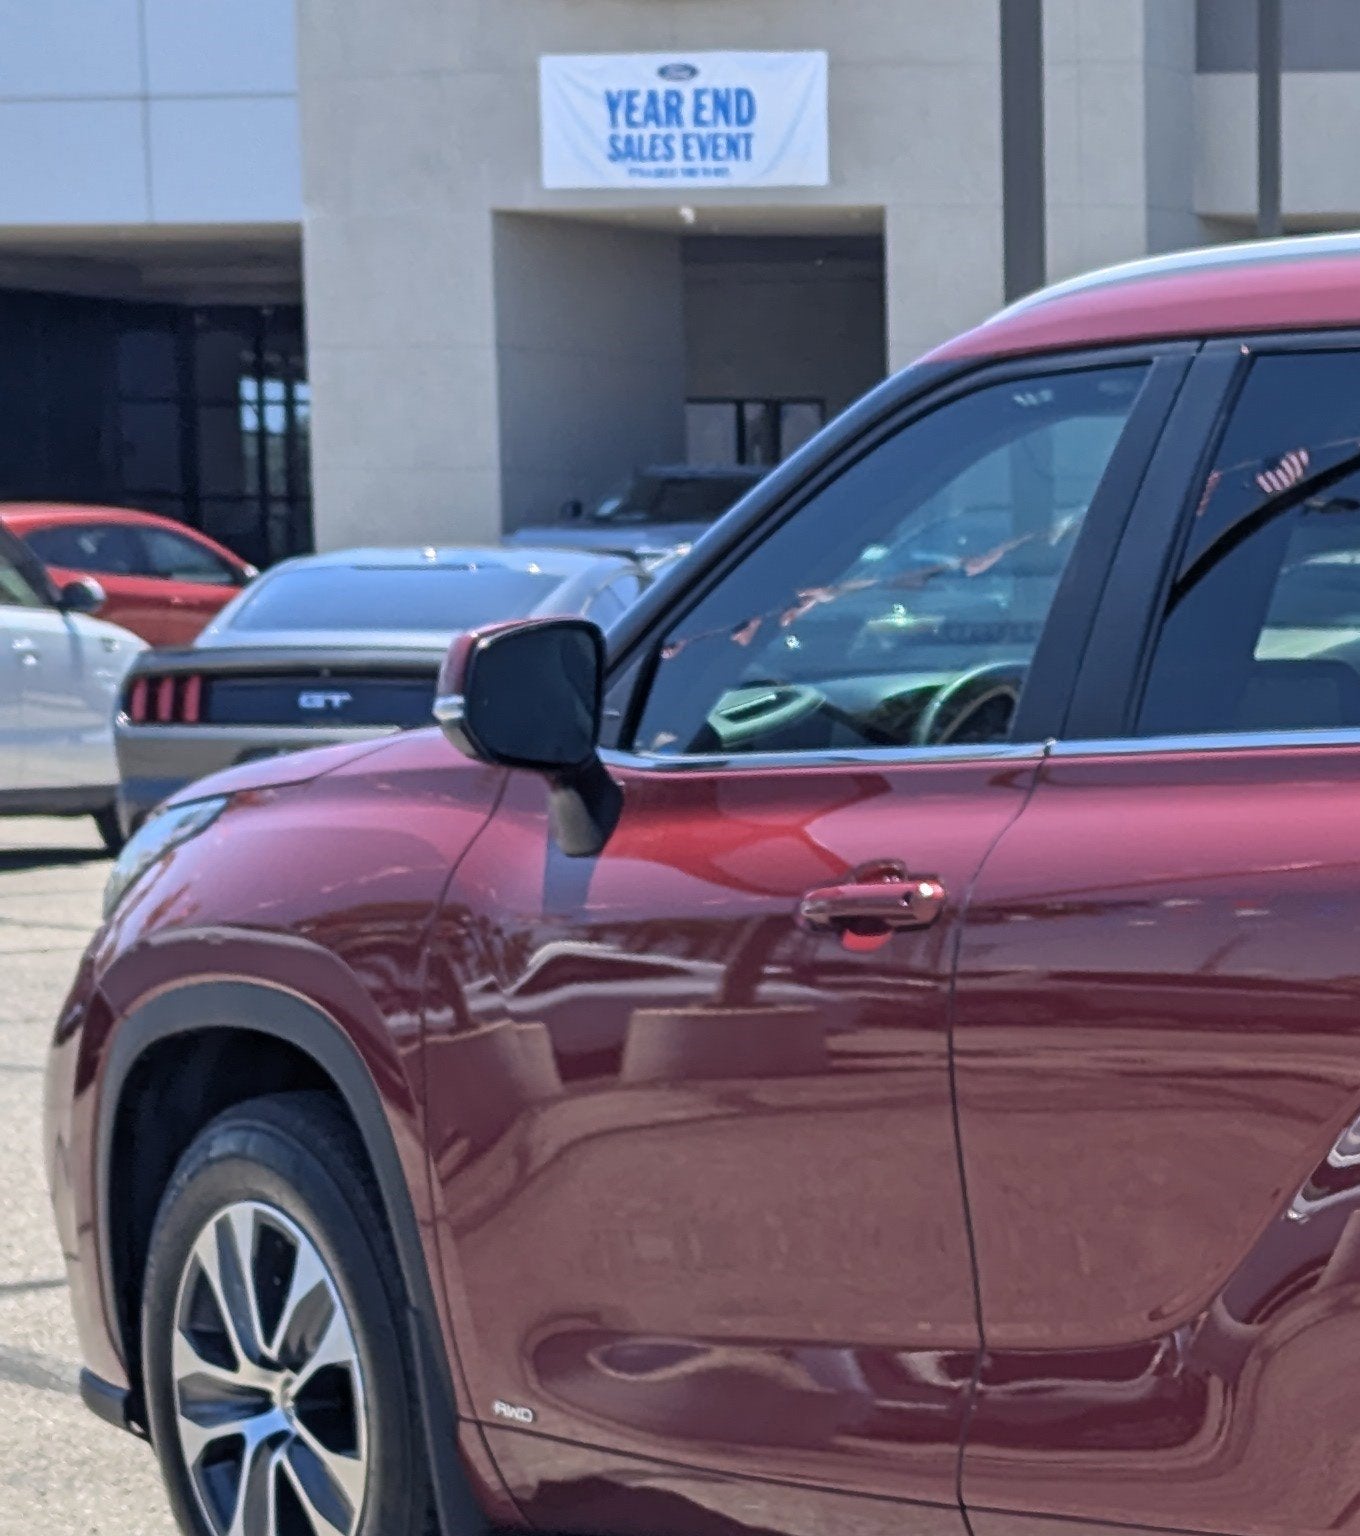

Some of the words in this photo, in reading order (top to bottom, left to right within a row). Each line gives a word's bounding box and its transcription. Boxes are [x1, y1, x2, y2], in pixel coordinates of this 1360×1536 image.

[605, 89, 684, 129] YEAR
[693, 88, 756, 128] END
[607, 133, 676, 163] SALES
[681, 132, 753, 161] EVENT
[299, 692, 352, 708] GT
